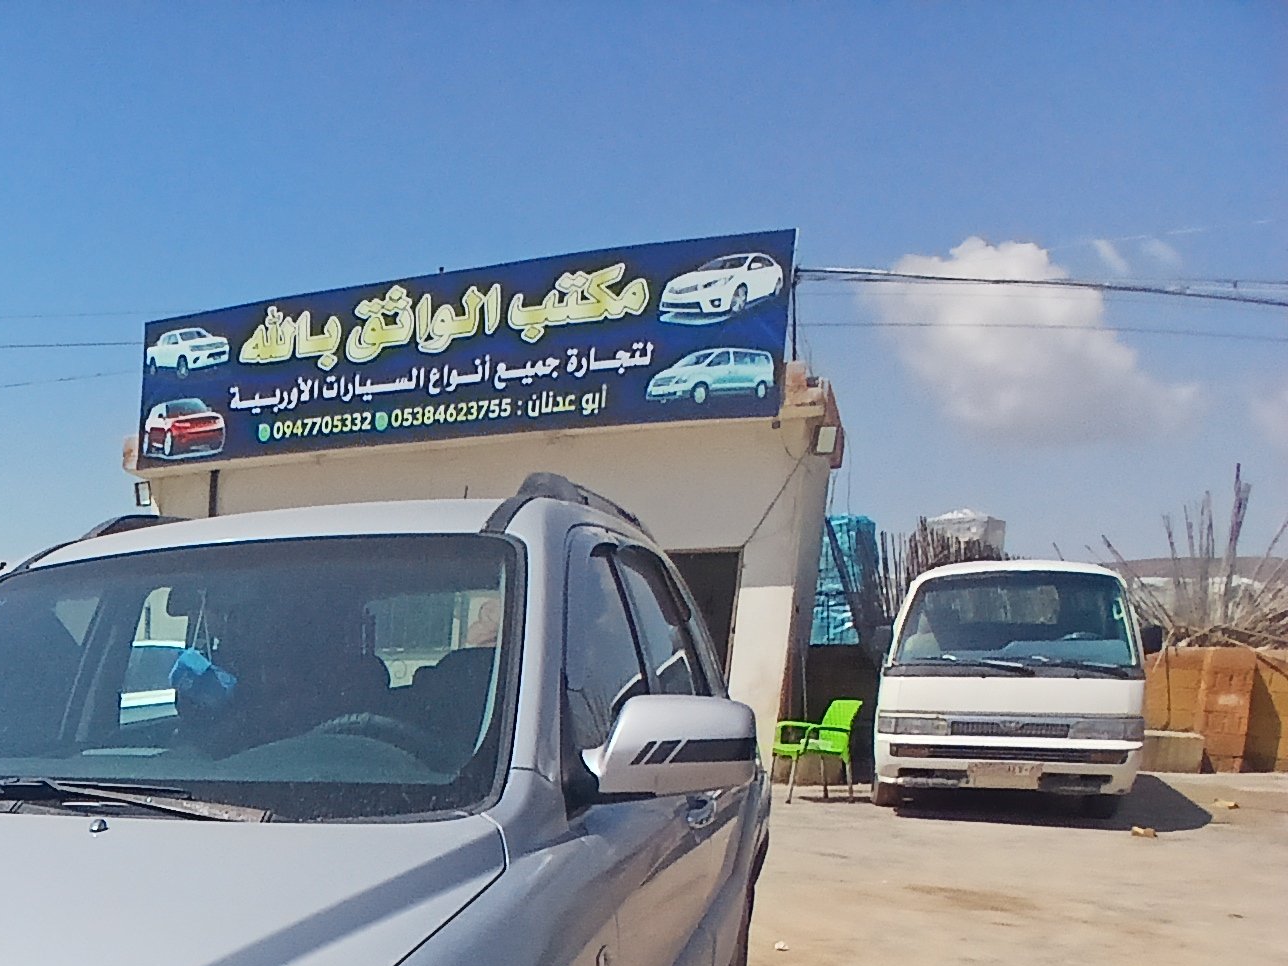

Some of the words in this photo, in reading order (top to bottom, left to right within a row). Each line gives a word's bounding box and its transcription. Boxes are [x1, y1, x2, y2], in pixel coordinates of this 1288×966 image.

[508, 262, 649, 343] مكتب
[239, 306, 342, 370] بالله
[346, 283, 501, 363] الواثق
[428, 354, 490, 395] أنواع
[494, 355, 560, 390] جميع
[566, 341, 654, 377] لتجارة
[230, 376, 319, 413] الأوربية
[323, 366, 424, 401] السيارات
[582, 384, 607, 415] أبو
[391, 398, 511, 427] 05384623755
[527, 389, 576, 417] عدنان
[273, 411, 372, 440] 0947705332
